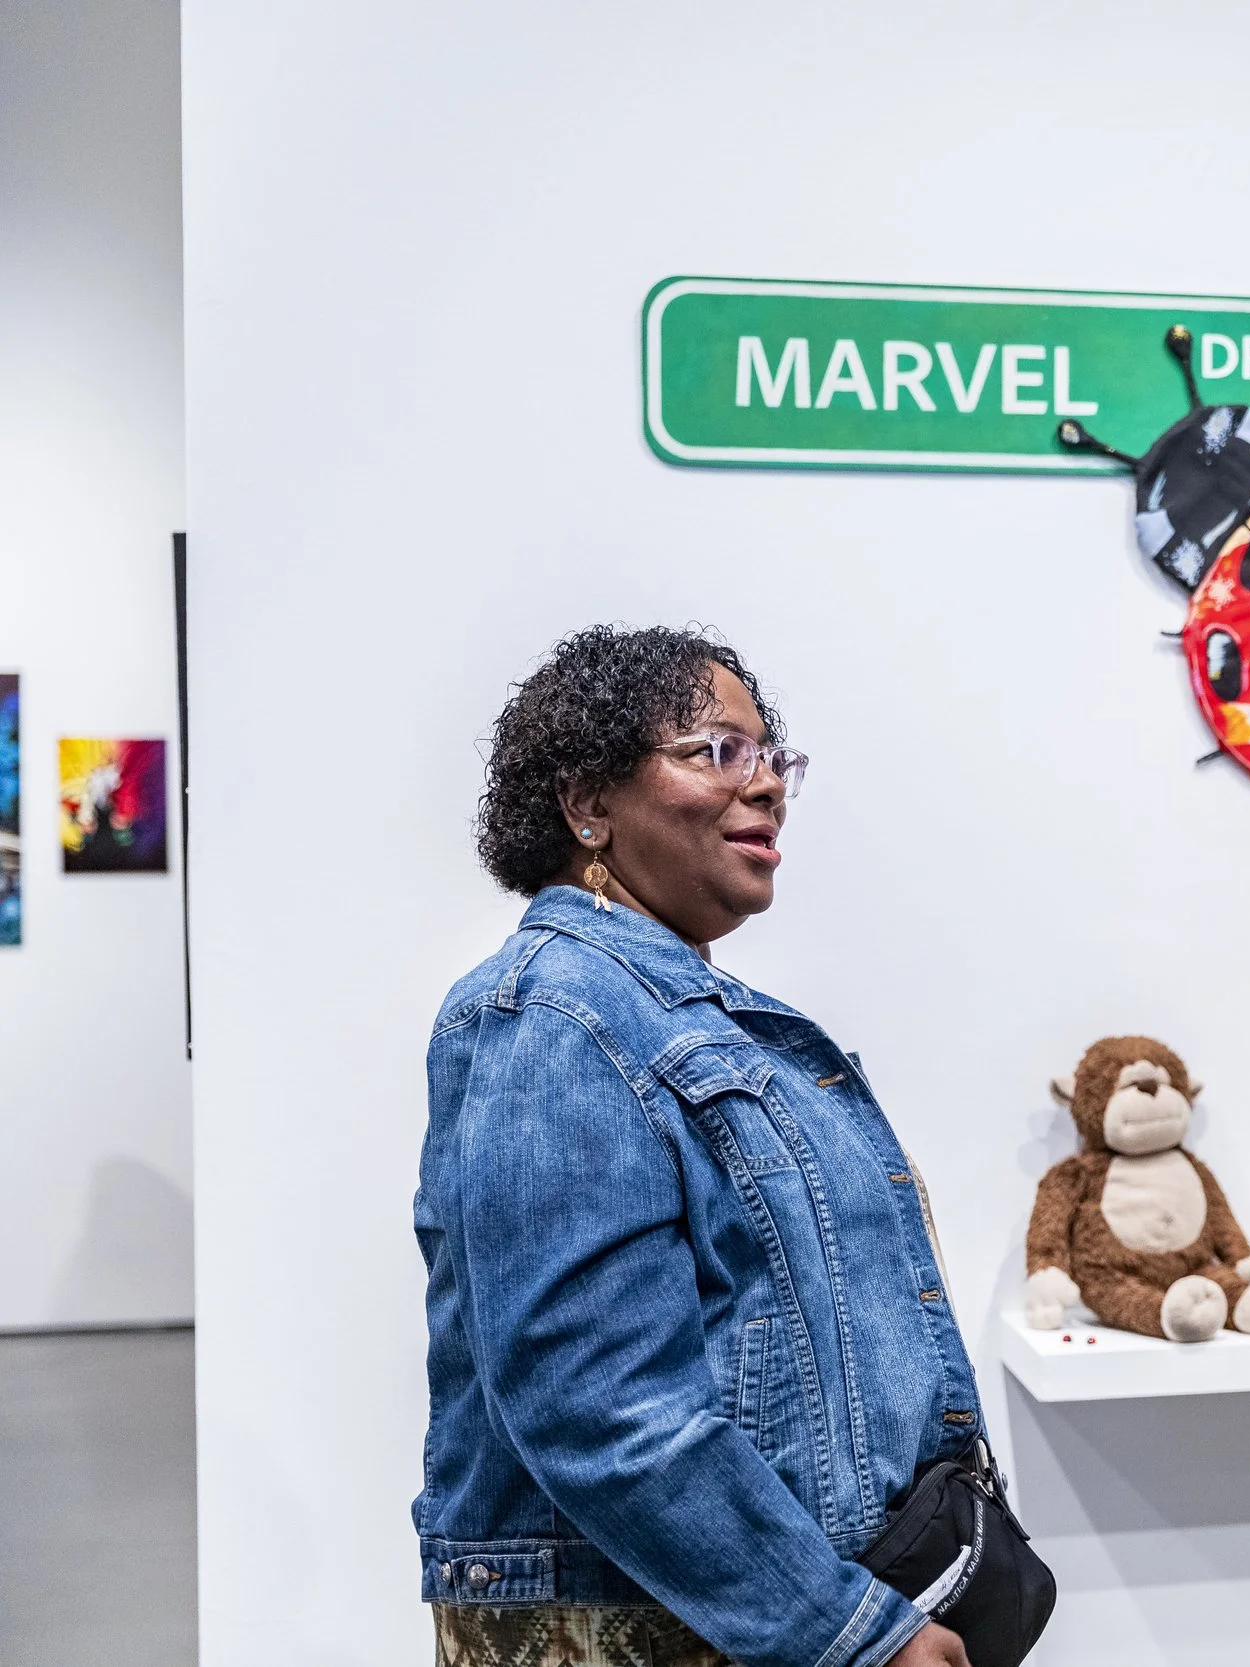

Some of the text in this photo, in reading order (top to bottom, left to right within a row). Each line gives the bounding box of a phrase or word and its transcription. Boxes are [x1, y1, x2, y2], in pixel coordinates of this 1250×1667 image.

[734, 335, 1099, 416] MARVEL
[937, 1500, 984, 1615] NAUTICA NAUTICA NAUTICA
